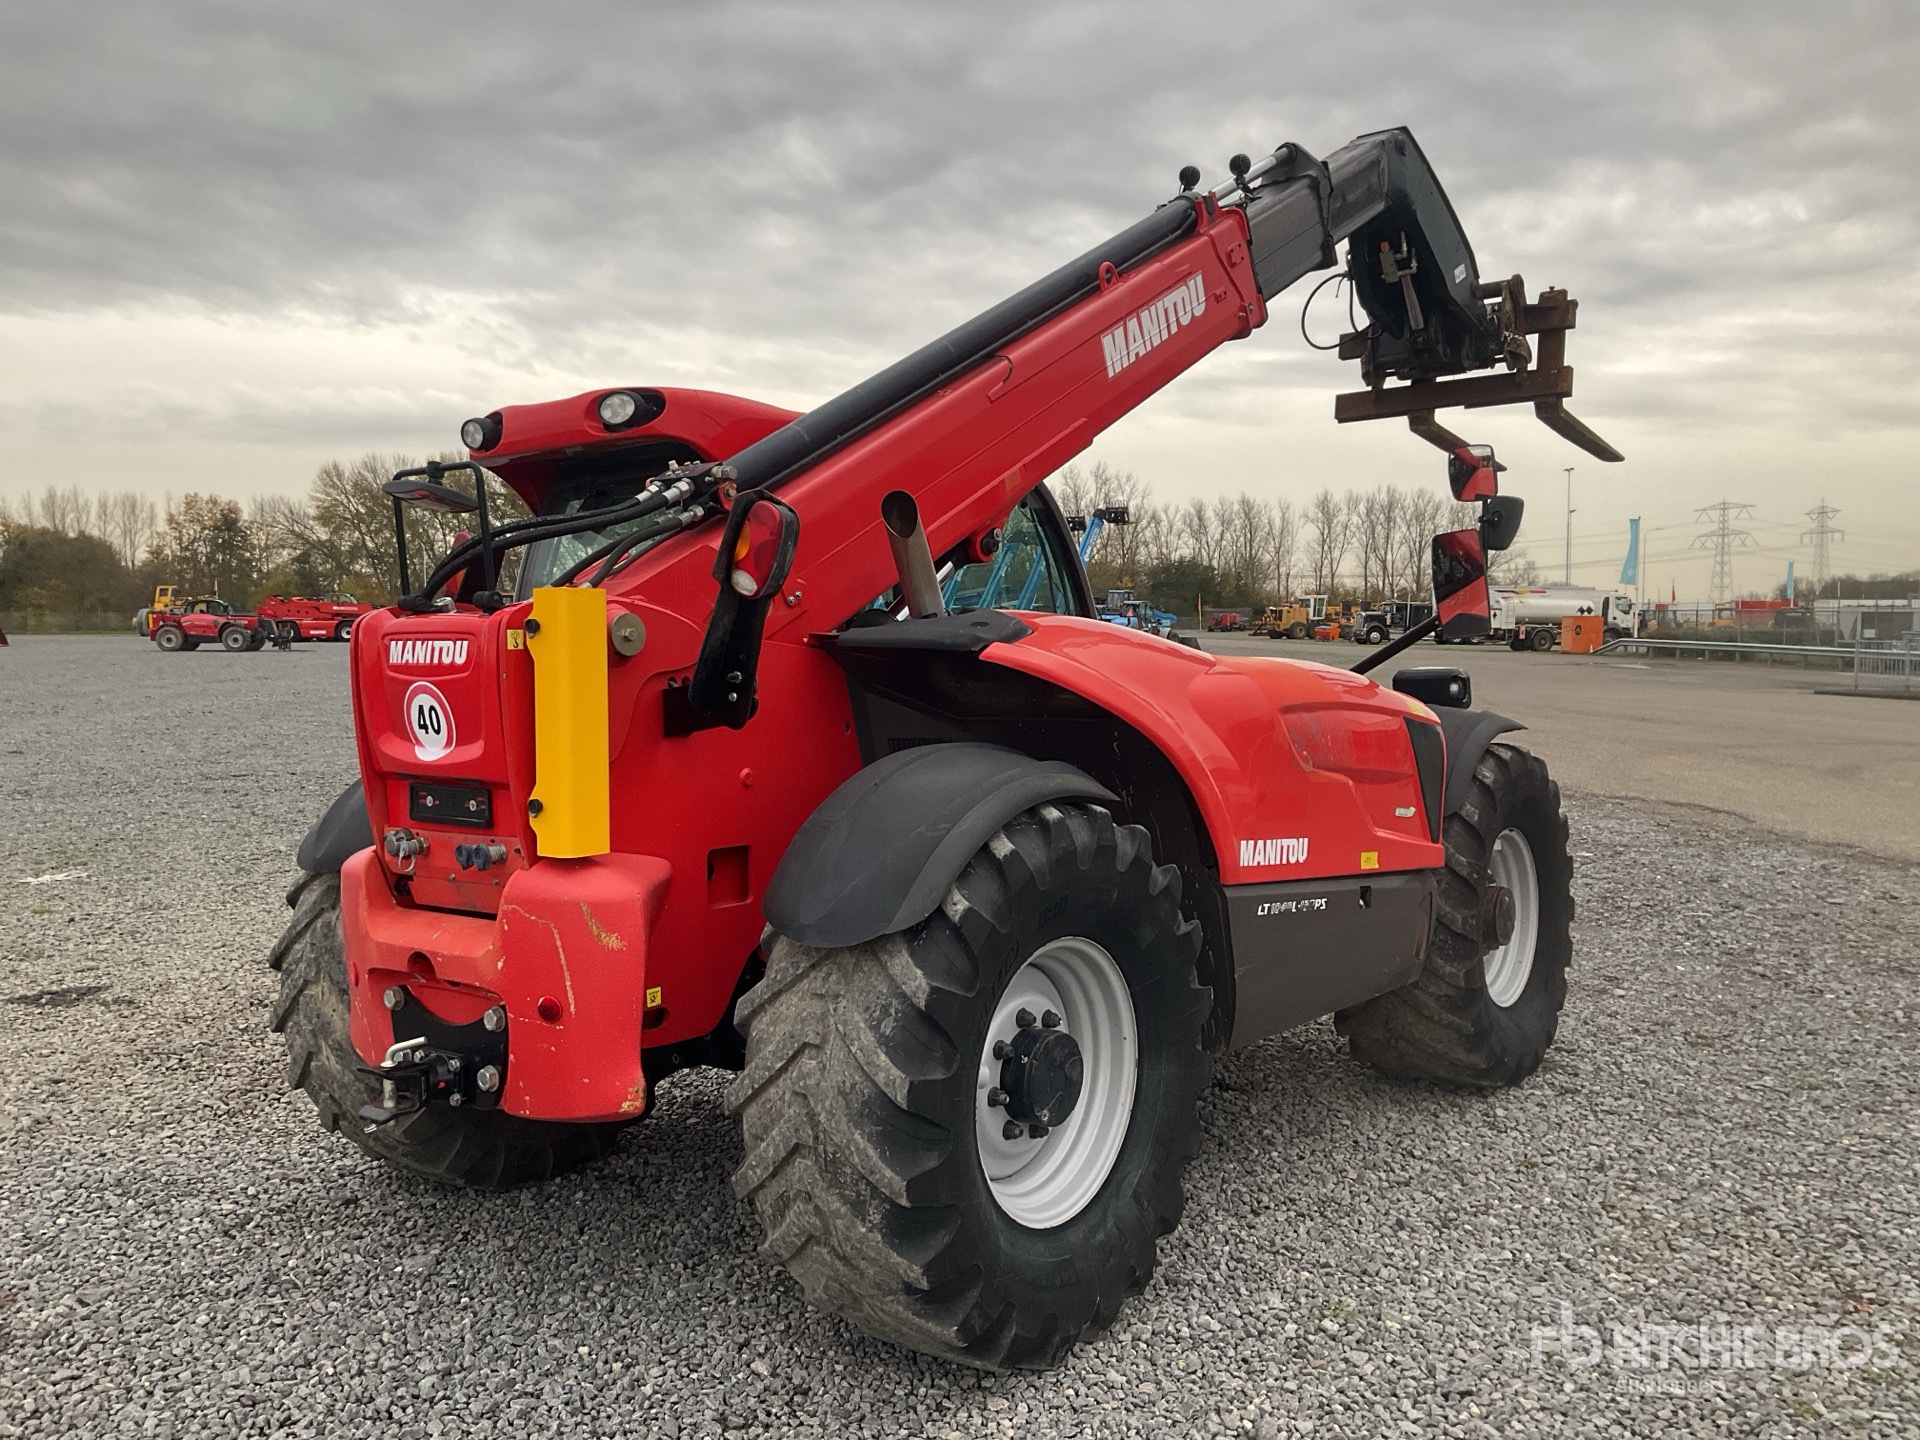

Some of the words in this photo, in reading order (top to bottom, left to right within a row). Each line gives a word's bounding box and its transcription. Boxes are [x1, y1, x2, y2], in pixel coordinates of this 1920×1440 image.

[1102, 274, 1206, 379] MANITOU
[389, 640, 469, 665] MANITOU
[418, 705, 442, 735] 40
[1240, 838, 1308, 866] MANITOU
